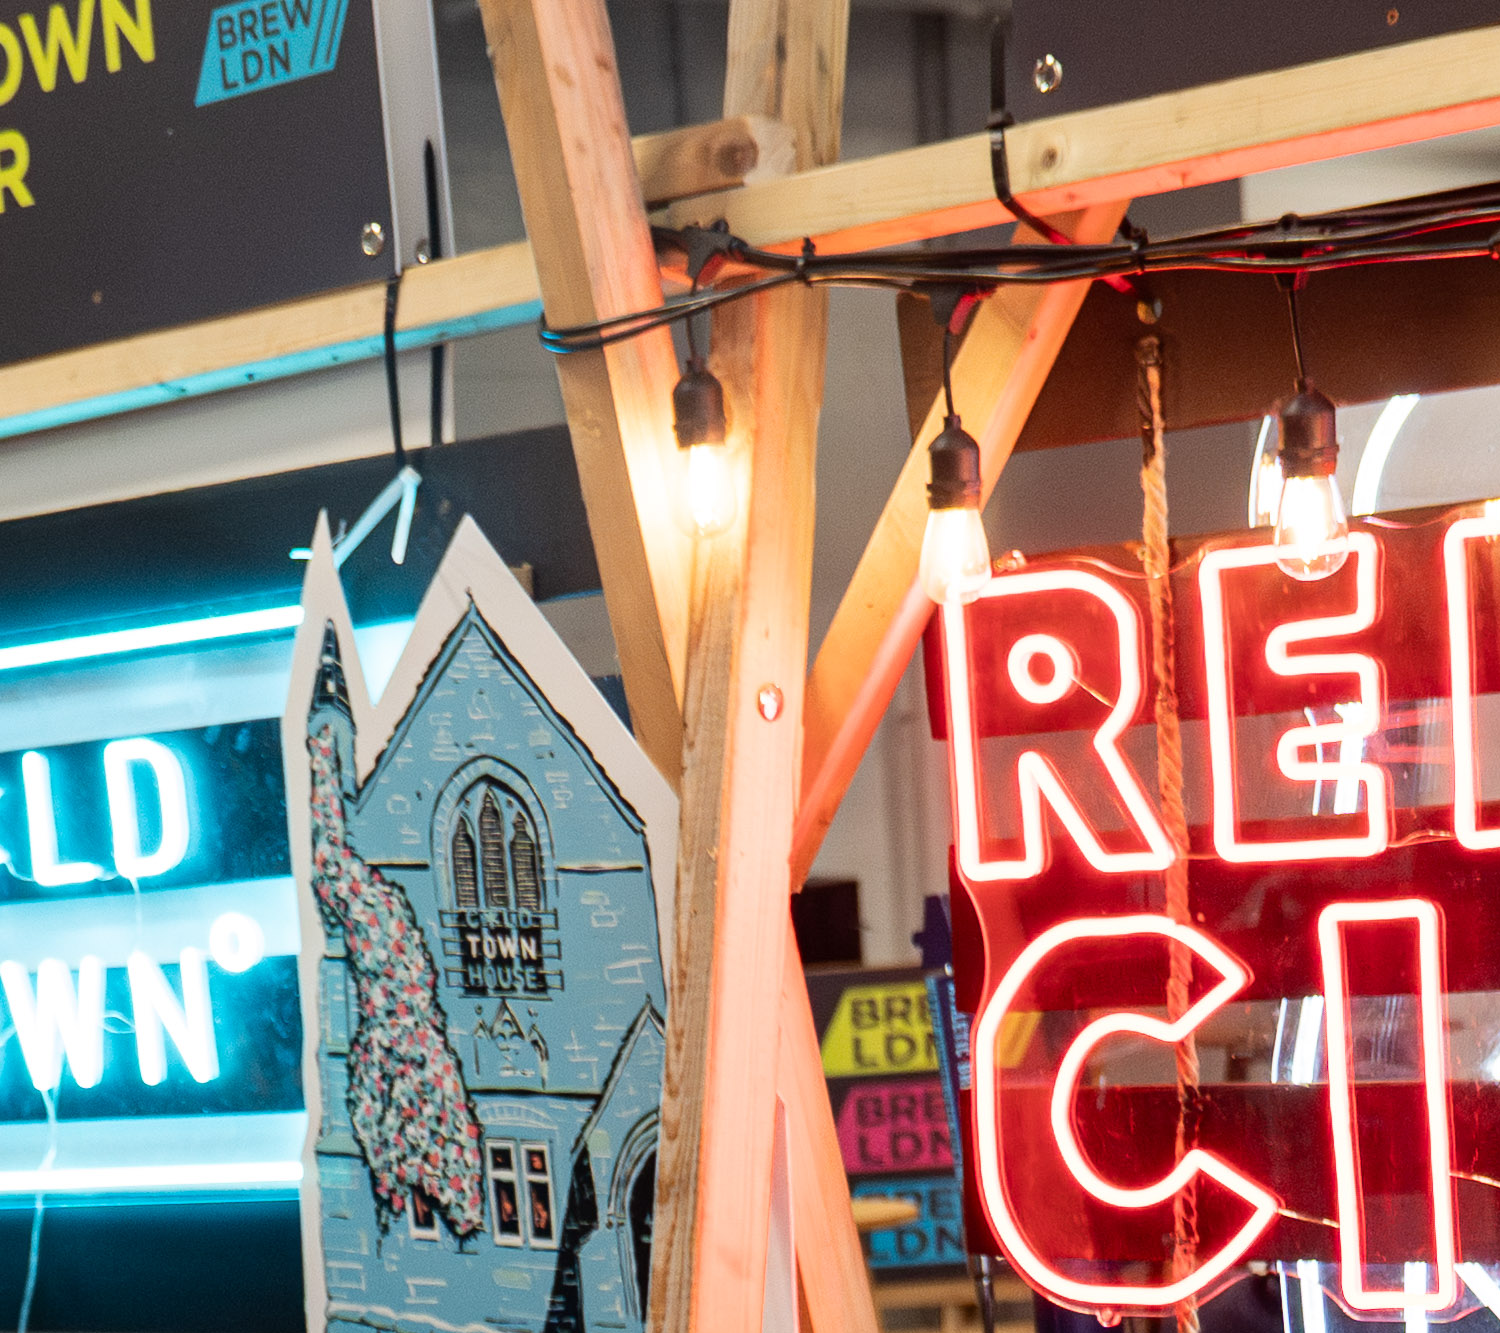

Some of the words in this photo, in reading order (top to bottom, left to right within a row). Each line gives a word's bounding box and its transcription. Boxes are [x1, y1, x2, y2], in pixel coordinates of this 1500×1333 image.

[215, 0, 314, 53] BREW
[220, 38, 294, 91] LDN
[465, 933, 538, 961] TOWN
[467, 962, 538, 990] HOUSE
